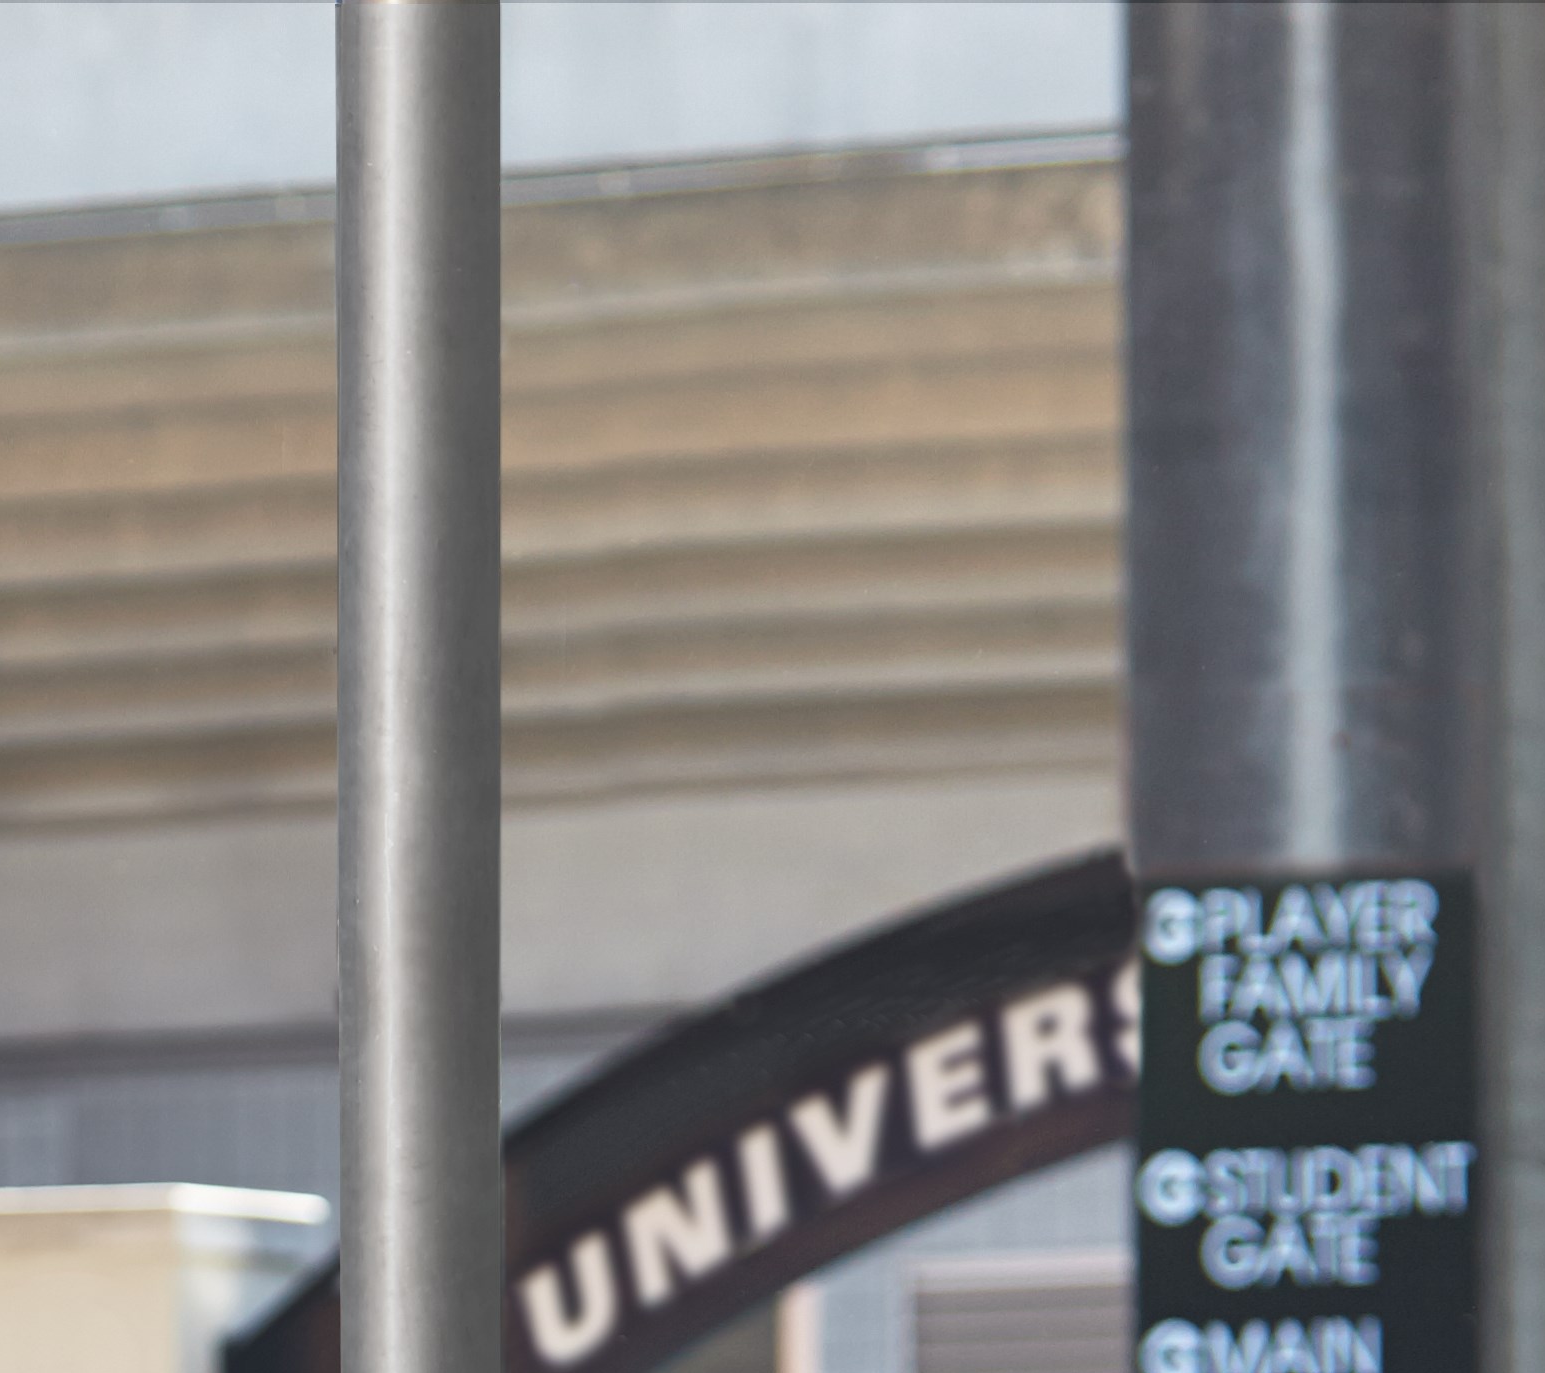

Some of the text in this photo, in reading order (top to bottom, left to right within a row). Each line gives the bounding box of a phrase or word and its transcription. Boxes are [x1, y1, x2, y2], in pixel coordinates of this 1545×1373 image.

[1200, 879, 1438, 952] PLAYER
[1198, 943, 1435, 1022] FAMILY
[1198, 1019, 1376, 1094] GATE
[1202, 1142, 1476, 1217] STUDENT
[1200, 1212, 1379, 1290] GATE
